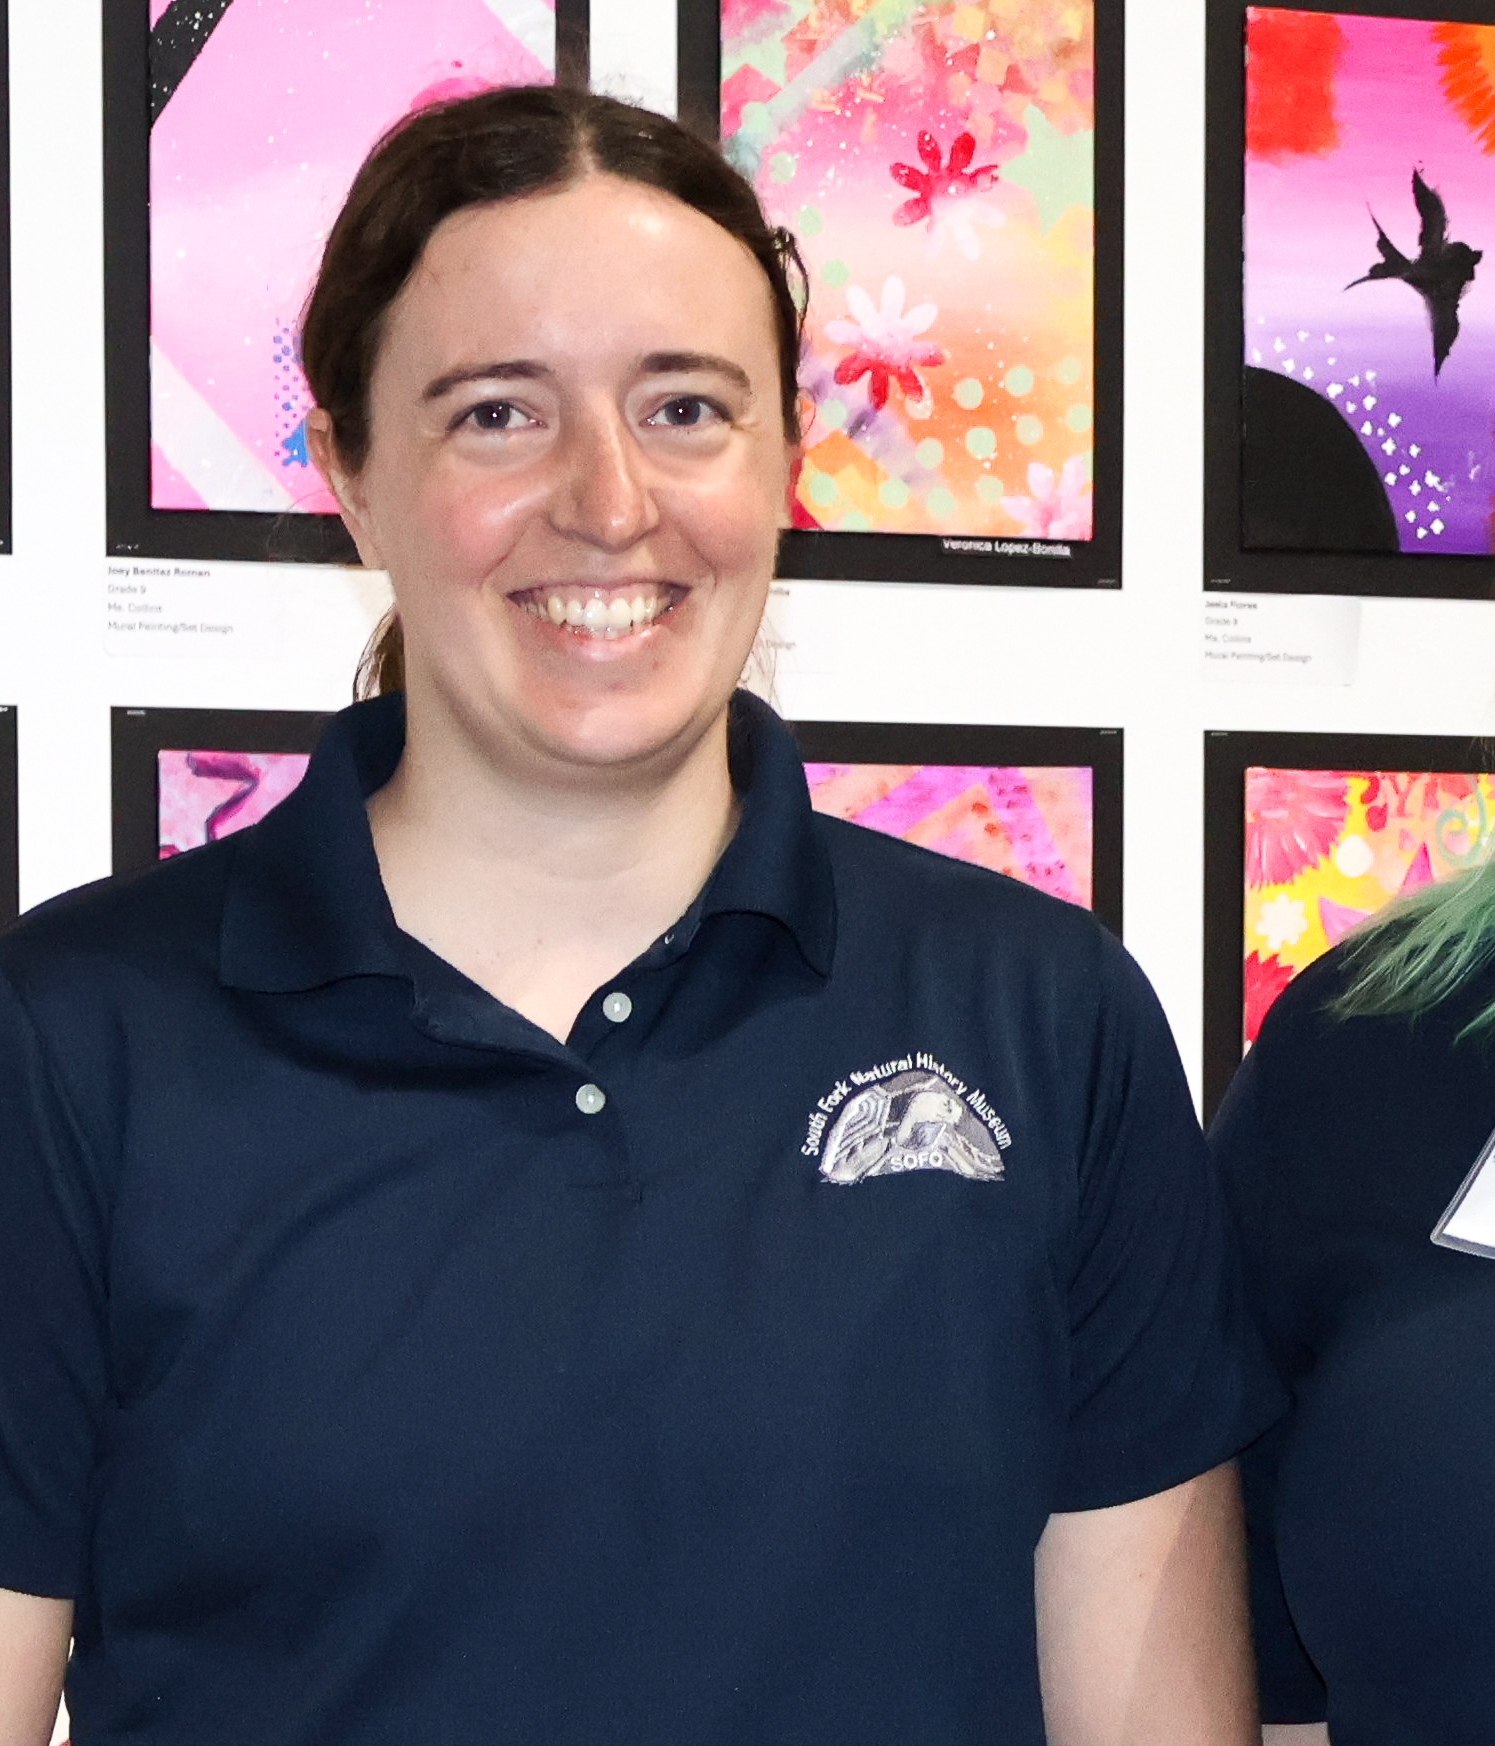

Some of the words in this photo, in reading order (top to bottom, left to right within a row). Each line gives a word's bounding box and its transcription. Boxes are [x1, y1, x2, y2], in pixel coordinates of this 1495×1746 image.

[817, 1080, 852, 1113] Fork
[849, 1053, 913, 1086] Natural
[916, 1051, 967, 1096] History
[966, 1089, 1012, 1150] Museum
[890, 1153, 943, 1172] SOFO
